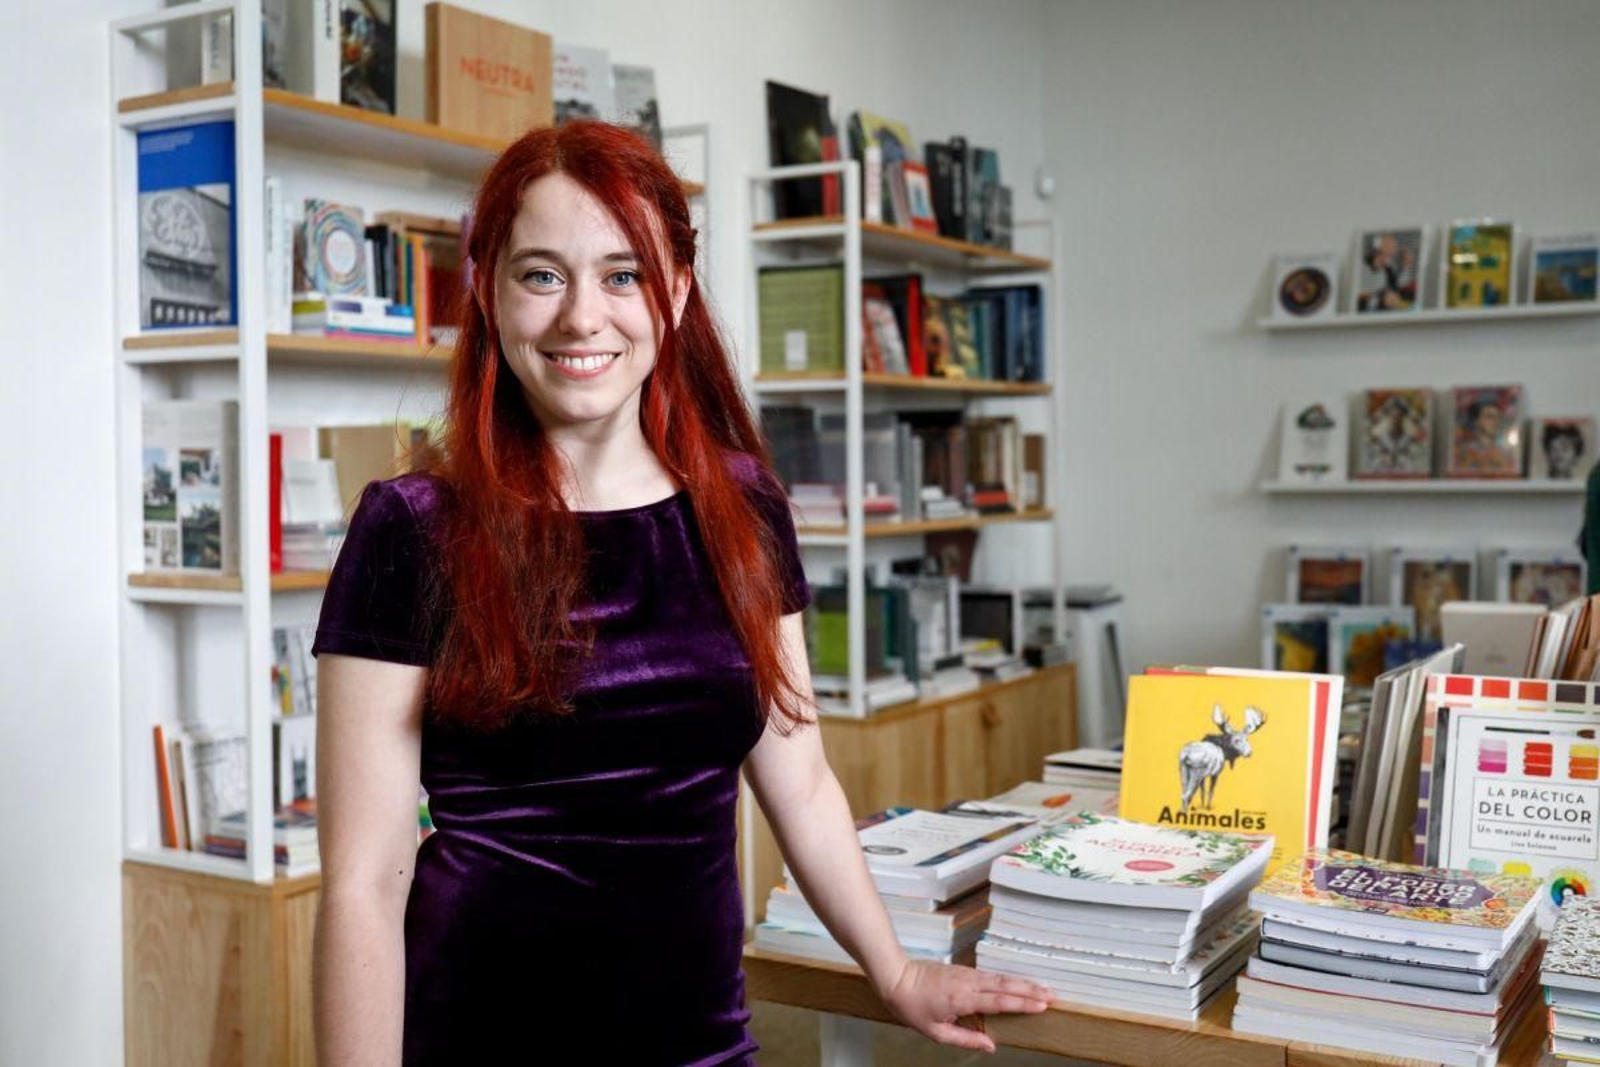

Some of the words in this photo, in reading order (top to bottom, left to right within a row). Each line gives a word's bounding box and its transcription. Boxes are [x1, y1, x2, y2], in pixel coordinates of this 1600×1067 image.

[459, 55, 534, 93] NEUTRA
[1488, 787, 1505, 797] LA
[1511, 788, 1585, 804] PRÁCTICA
[1157, 805, 1266, 830] Animales
[1479, 801, 1515, 817] DEL
[1523, 805, 1592, 824] COLOR
[1477, 824, 1491, 833] Un
[1495, 827, 1531, 838] manual
[1534, 830, 1546, 839] de
[1549, 833, 1592, 844] acuarela
[1328, 880, 1380, 894] DEL
[1388, 891, 1468, 905] ARTE
[1382, 876, 1477, 893] PODER
